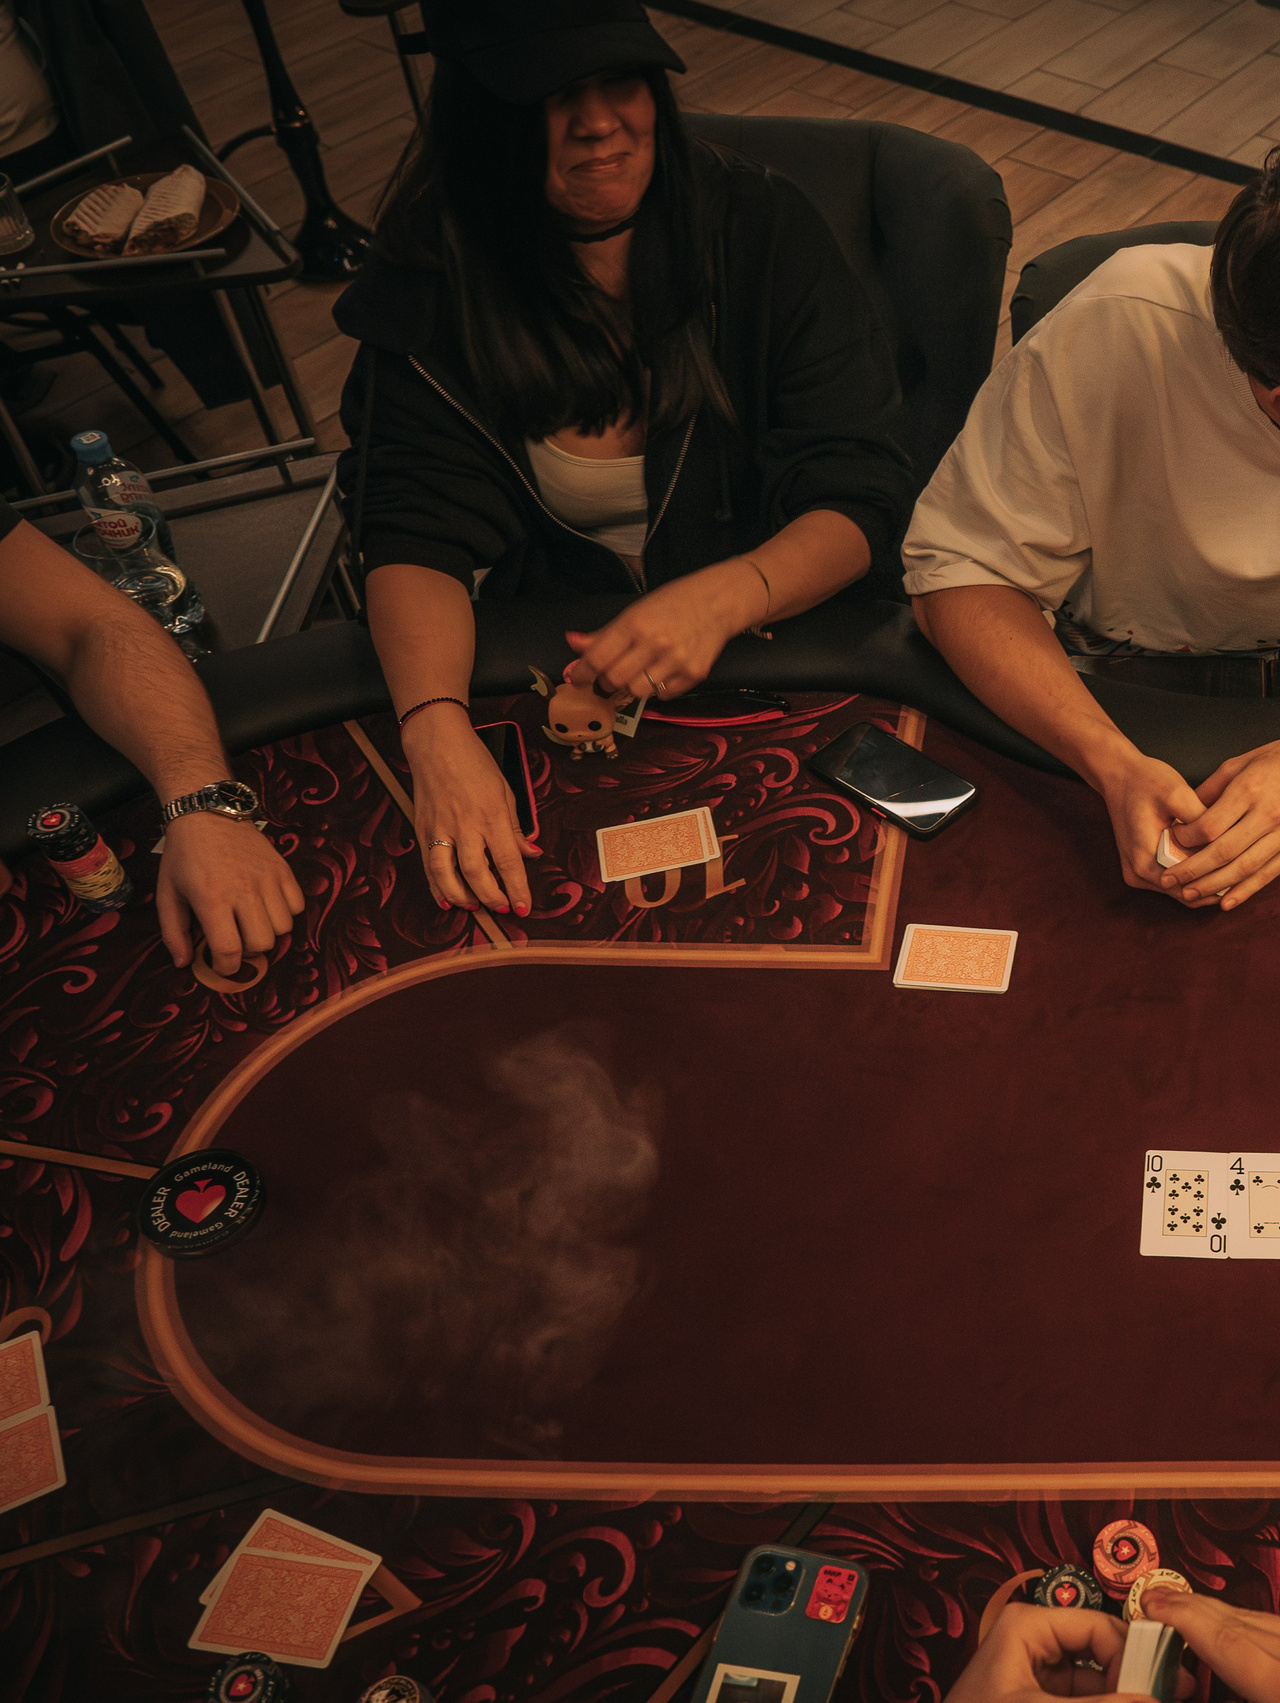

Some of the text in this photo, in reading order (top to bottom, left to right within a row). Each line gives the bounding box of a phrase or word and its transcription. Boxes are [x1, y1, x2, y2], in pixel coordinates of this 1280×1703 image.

[174, 1161, 234, 1182] Gameland
[1146, 1154, 1163, 1173] 10
[1229, 1157, 1245, 1175] 4
[224, 1170, 250, 1218] DEALER
[150, 1186, 172, 1232] DEALER
[169, 1222, 224, 1240] Gameland
[1209, 1234, 1227, 1253] 10
[1158, 1570, 1182, 1581] EPT
[1131, 1582, 1141, 1605] EPT
